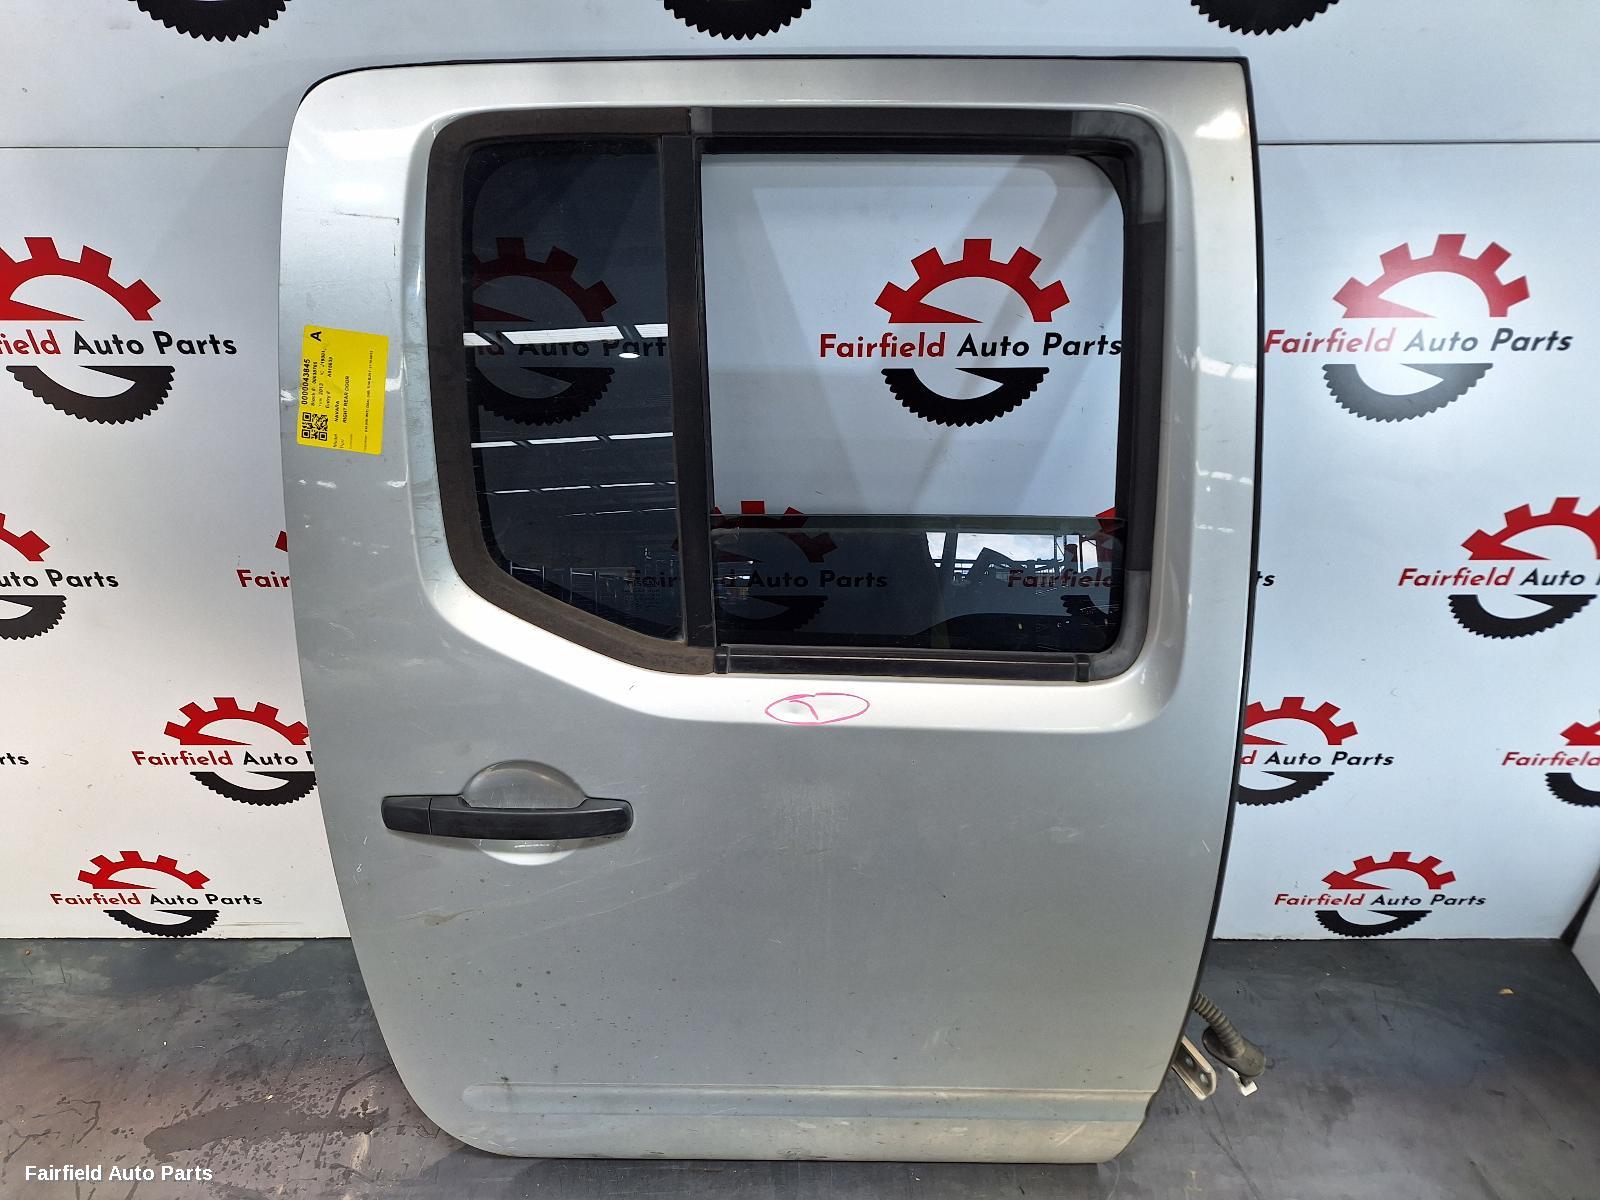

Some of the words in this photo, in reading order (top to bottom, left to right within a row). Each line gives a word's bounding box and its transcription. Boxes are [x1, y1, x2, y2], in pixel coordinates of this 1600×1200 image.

[73, 330, 145, 355] Auto
[152, 330, 238, 355] Parts
[310, 331, 322, 342] A
[819, 331, 946, 359] Fairfield
[956, 332, 1030, 357] Auto
[1042, 331, 1123, 357] Parts
[1264, 327, 1398, 354] Fairfield
[1403, 328, 1479, 353] Auto
[1489, 327, 1575, 353] Parts
[301, 359, 311, 405] 0000043845
[44, 568, 120, 588] Parts
[236, 569, 290, 588] Fair
[748, 570, 809, 589] Auto
[819, 569, 888, 589] Parts
[1397, 566, 1516, 587] Fairfield
[1519, 567, 1586, 587] Auto
[131, 750, 234, 766] Fairfield
[242, 750, 299, 766] Auto
[1264, 750, 1322, 766] Auto
[1330, 750, 1395, 766] Parts
[49, 892, 142, 906] Fairfield
[149, 893, 199, 906] Auto
[204, 893, 263, 906] Parts
[1274, 892, 1367, 906] Fairfield
[1370, 893, 1423, 906] Auto
[1429, 893, 1487, 906] Parts
